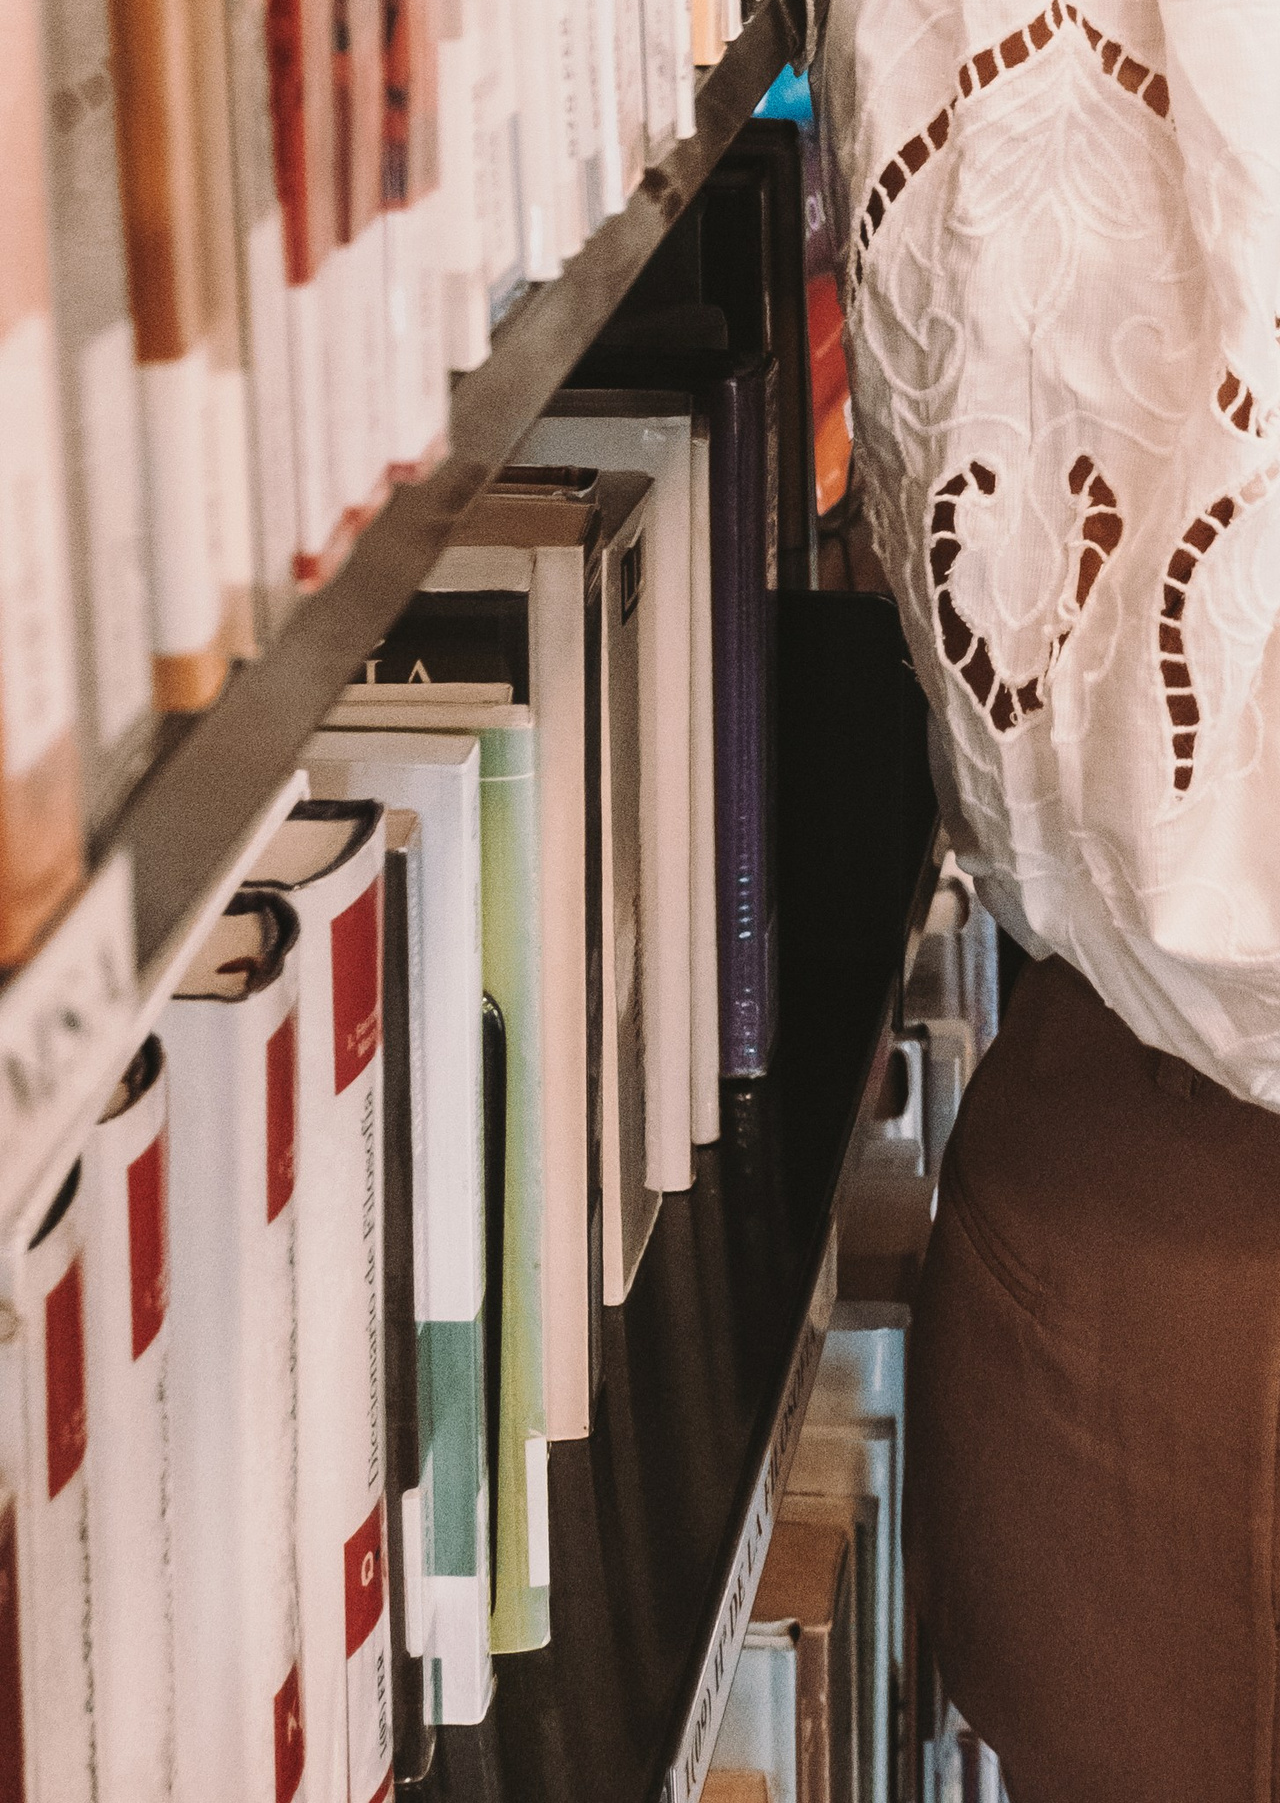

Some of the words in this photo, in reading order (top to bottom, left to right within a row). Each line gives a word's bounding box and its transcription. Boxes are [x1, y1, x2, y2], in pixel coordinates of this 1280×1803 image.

[360, 1089, 376, 1241] Filosofía
[363, 1248, 376, 1286] de
[365, 1293, 380, 1491] Diccionario
[728, 1571, 747, 1636] DE
[744, 1516, 763, 1576] LA
